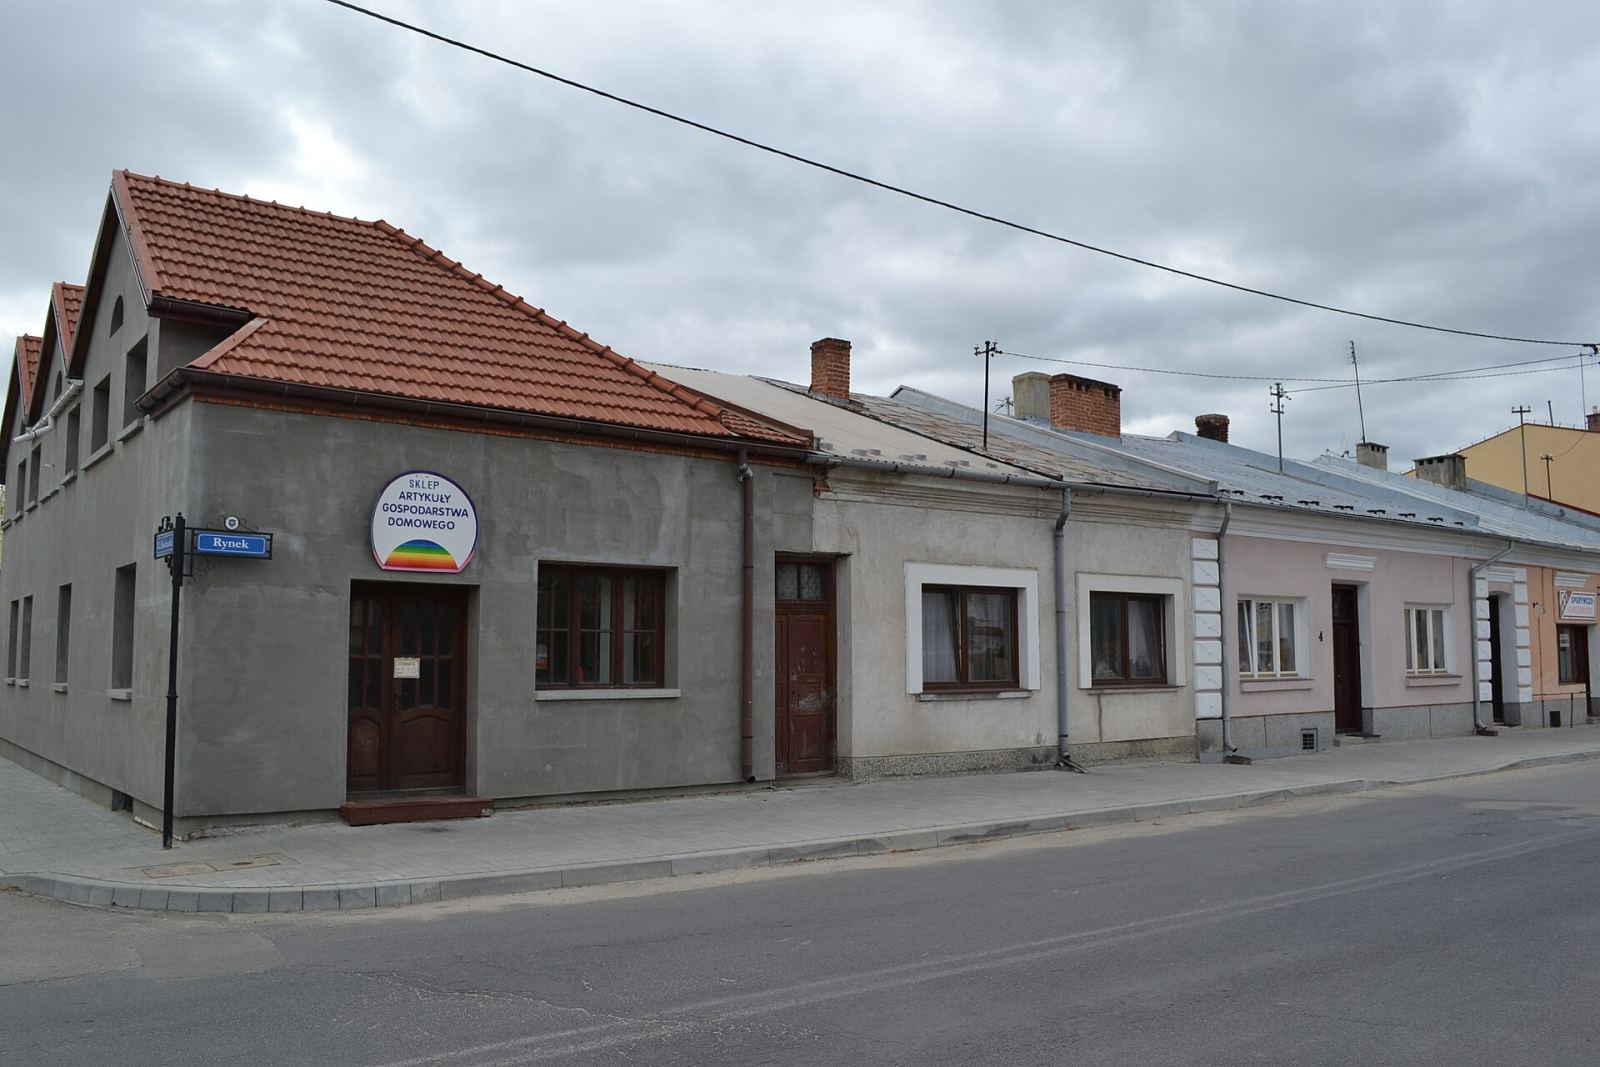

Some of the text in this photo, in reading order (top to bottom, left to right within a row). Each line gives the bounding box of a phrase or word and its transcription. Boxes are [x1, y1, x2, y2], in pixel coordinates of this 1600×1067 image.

[409, 479, 440, 490] SKLEP
[399, 491, 451, 503] ARTYKUŁY
[382, 503, 469, 518] GOSPODARSTWA
[388, 517, 455, 530] DOMOWEGO
[212, 537, 249, 550] Rynek
